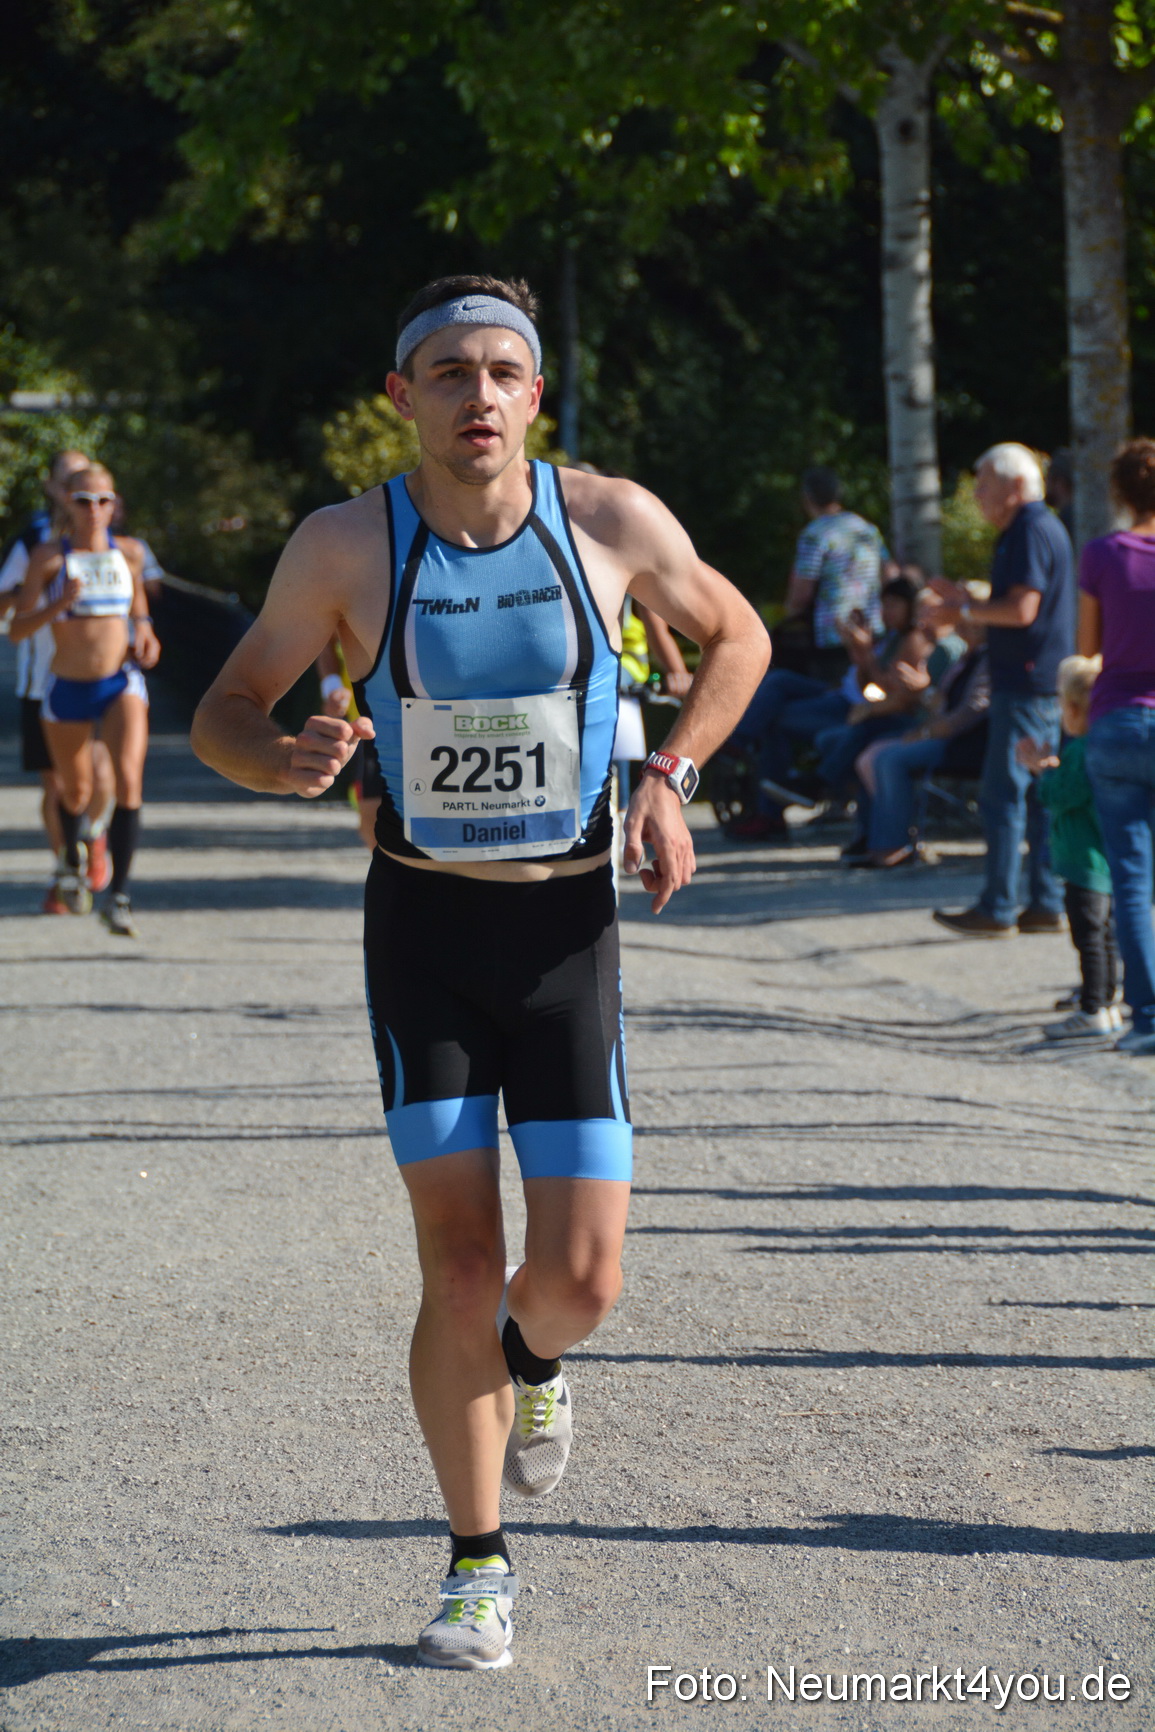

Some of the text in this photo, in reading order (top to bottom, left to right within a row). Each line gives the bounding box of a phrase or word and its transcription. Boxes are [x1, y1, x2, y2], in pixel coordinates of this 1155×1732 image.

[454, 713, 529, 732] BOCK
[430, 742, 545, 793] 2251
[414, 783, 421, 792] A
[442, 799, 531, 811] PARTL Neumarkt
[462, 820, 526, 843] Daniel
